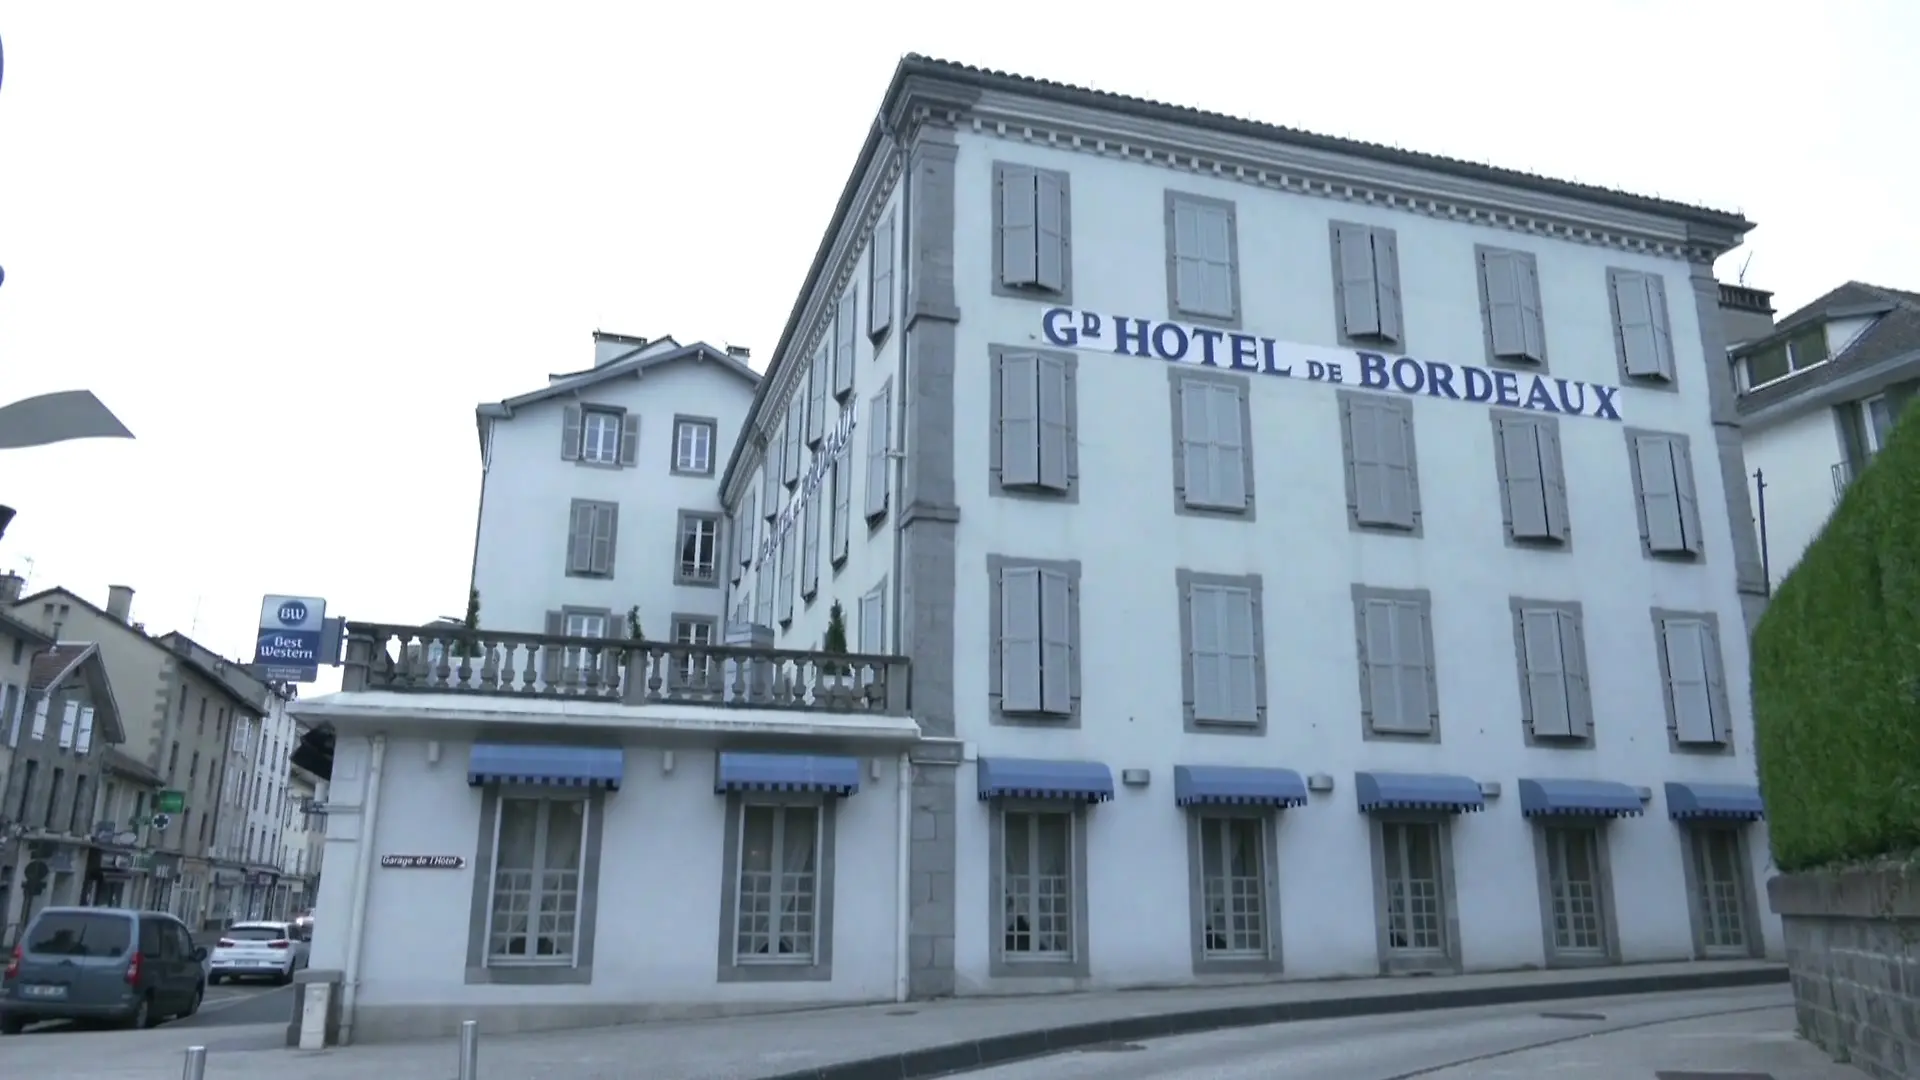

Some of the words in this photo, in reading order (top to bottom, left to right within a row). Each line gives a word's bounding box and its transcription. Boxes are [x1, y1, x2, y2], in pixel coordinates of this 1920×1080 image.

[1112, 316, 1292, 377] HOTEL
[1306, 360, 1343, 382] DE
[1356, 351, 1622, 420] BORDEAUX
[281, 607, 305, 620] BW
[274, 636, 303, 648] Best
[261, 646, 313, 659] Western
[382, 856, 413, 868] Garage
[416, 856, 427, 865] de
